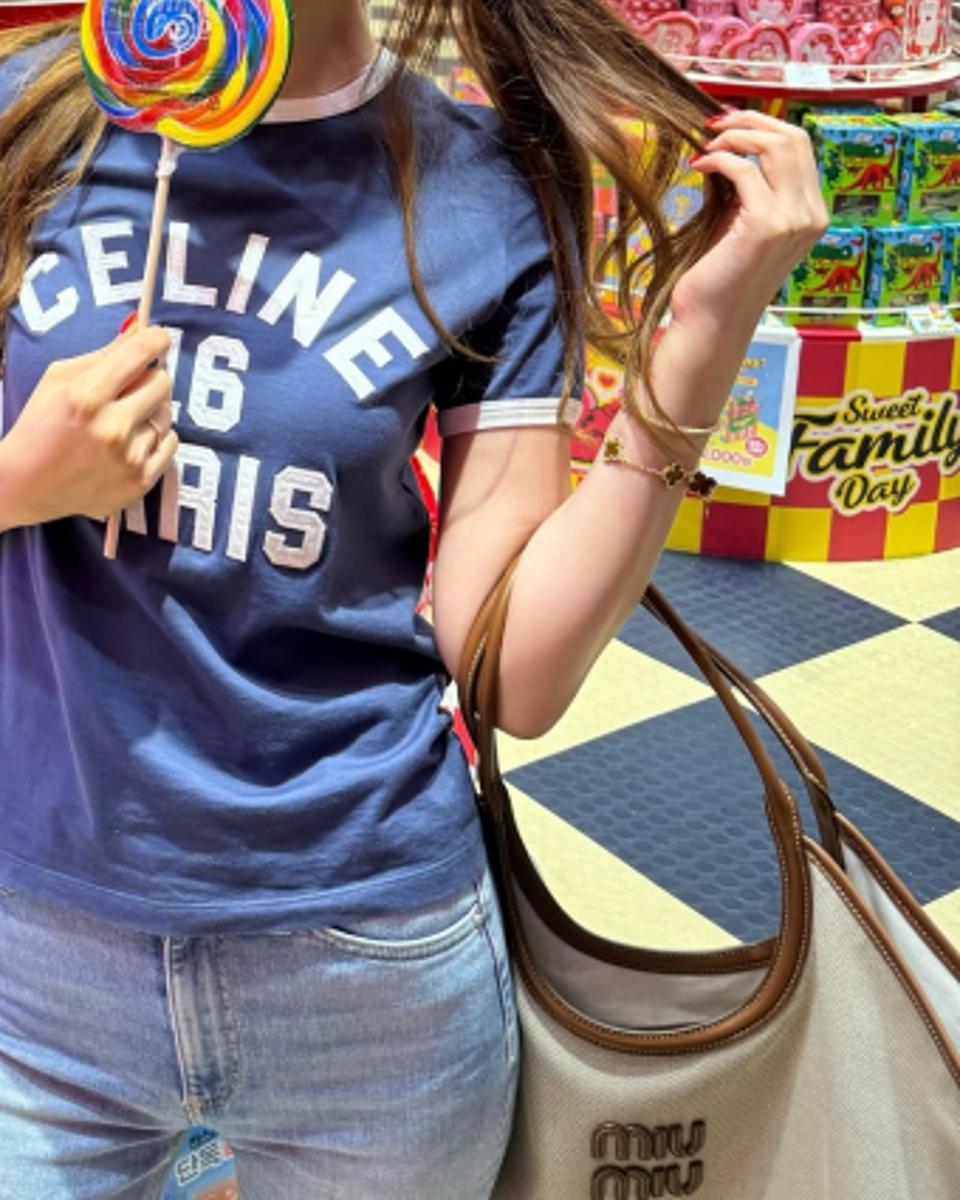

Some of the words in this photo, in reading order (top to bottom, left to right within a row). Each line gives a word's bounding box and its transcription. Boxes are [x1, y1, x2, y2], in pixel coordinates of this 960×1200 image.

[18, 219, 431, 400] CELINE
[843, 394, 921, 424] Sweet
[94, 443, 334, 571] RIS
[835, 474, 916, 509] Day
